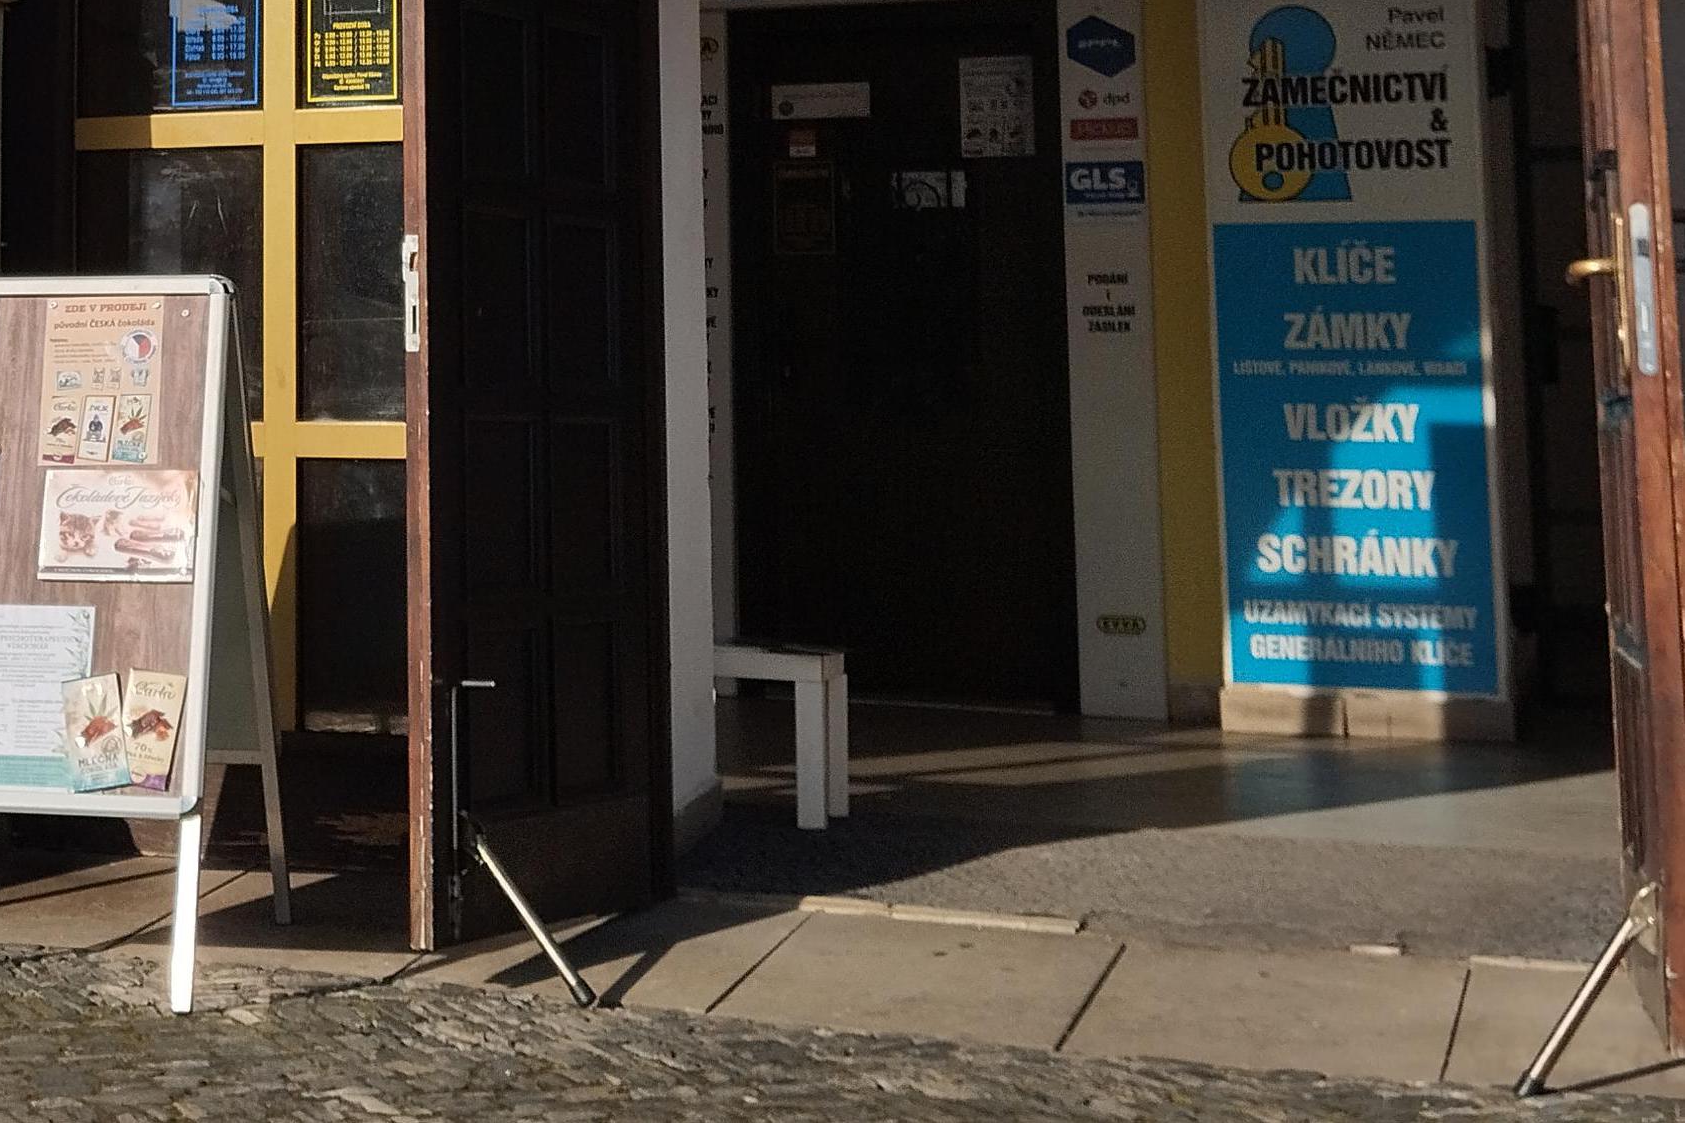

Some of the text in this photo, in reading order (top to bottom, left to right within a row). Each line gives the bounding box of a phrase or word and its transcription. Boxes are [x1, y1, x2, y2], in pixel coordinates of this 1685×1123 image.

[1387, 6, 1444, 23] Pavel
[1366, 29, 1446, 51] NĚMEC
[1242, 64, 1448, 107] ZÁMEČNICTVÍ
[1430, 108, 1448, 132] &
[1255, 139, 1452, 172] POHOTOVOST
[1070, 167, 1126, 191] GLS
[1293, 239, 1397, 284] KLÍČE
[54, 318, 155, 331] původní ČESKÁ čokoláda
[65, 303, 147, 313] ZDE V PRODEJI
[1283, 305, 1411, 350] ZÁMKY
[1283, 396, 1419, 443] VLOŽKY
[1273, 468, 1436, 511] TREZORY
[1257, 529, 1459, 577] SCHRÁNKY
[1243, 598, 1478, 630] UZAMYKACÍ SYSTÉMY
[1249, 632, 1475, 667] GENERÁLNÍHO KLÍČE
